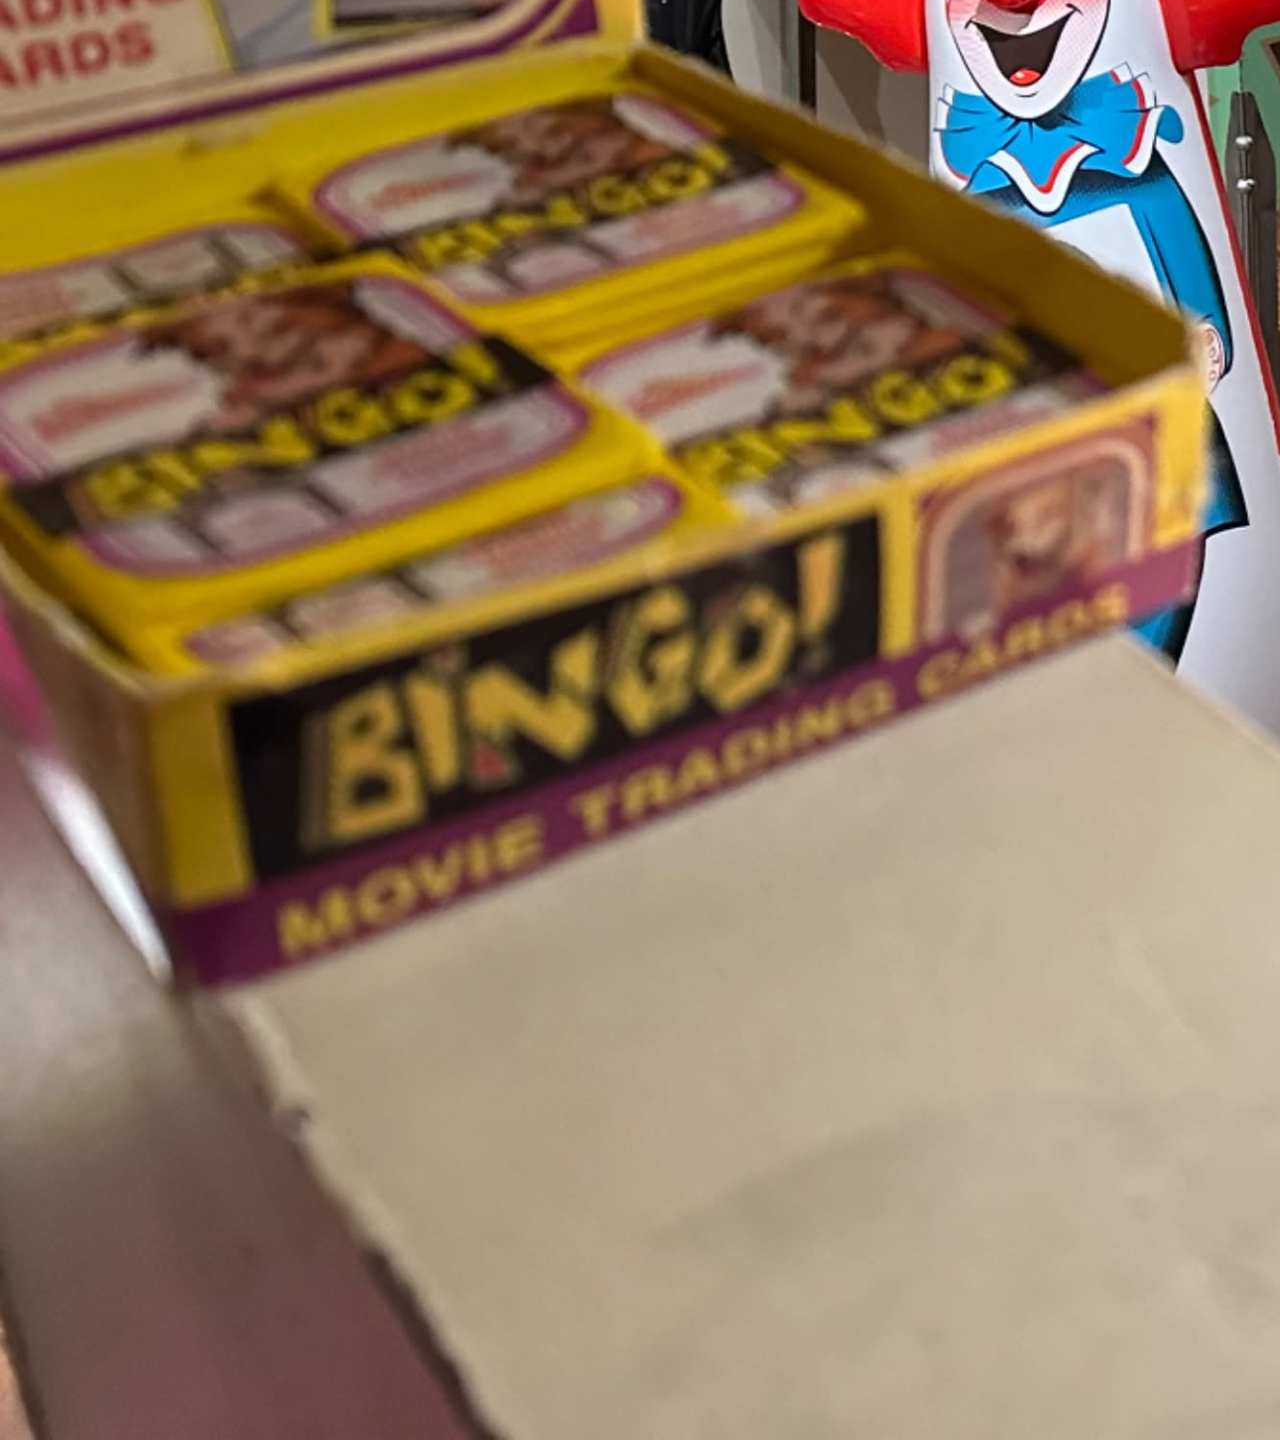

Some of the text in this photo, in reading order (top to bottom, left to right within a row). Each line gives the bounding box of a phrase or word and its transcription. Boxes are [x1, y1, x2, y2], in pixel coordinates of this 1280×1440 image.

[279, 581, 1132, 957] MOVIE TRADING CARDS
[306, 532, 846, 846] BINGO!
